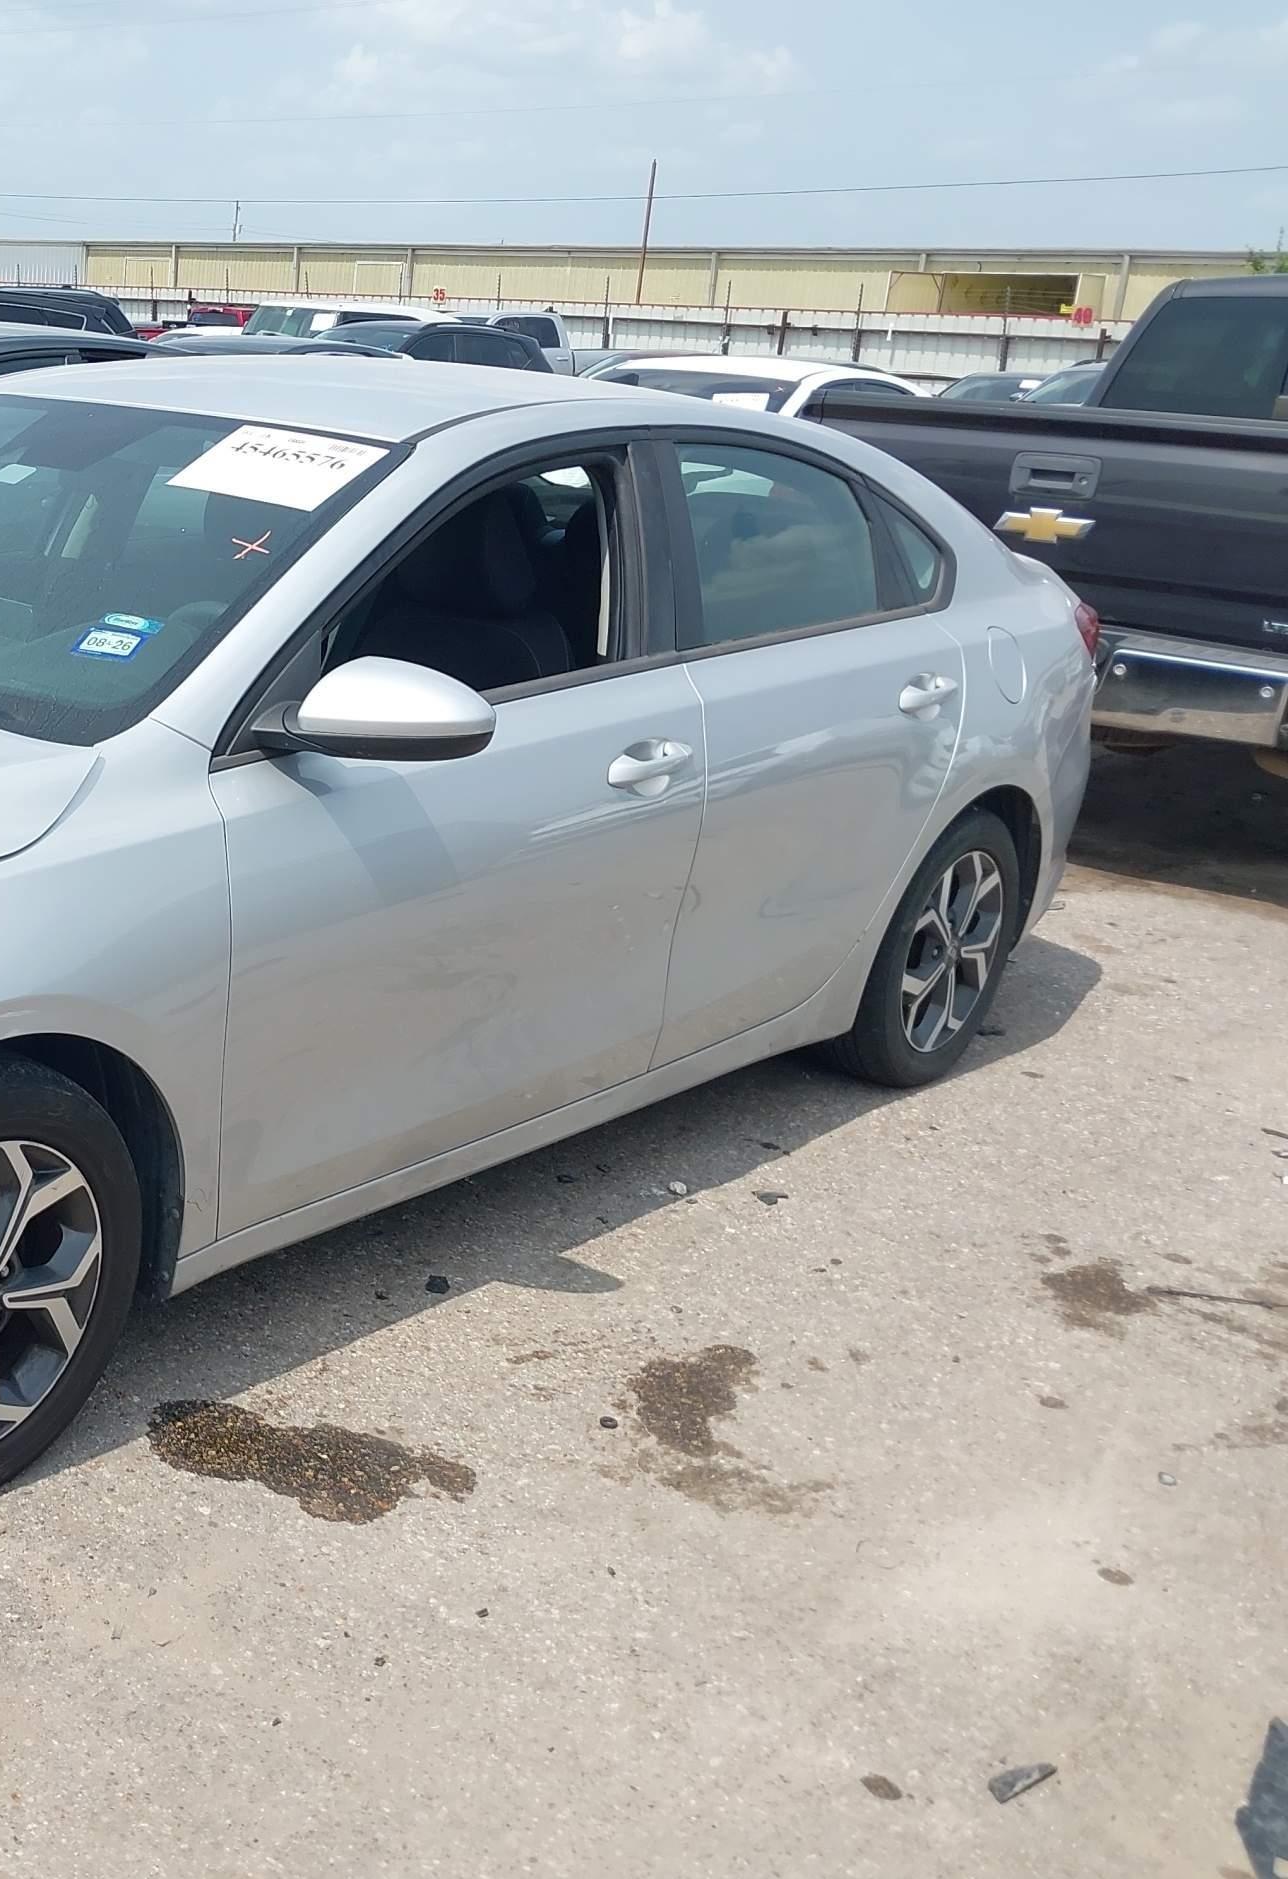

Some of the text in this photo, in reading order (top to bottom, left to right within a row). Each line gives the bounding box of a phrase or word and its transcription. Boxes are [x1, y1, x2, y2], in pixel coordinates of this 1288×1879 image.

[433, 288, 446, 301] 35
[1074, 307, 1092, 324] 40
[232, 441, 345, 469] 45465576
[86, 636, 107, 648] 08
[112, 639, 132, 651] 26
